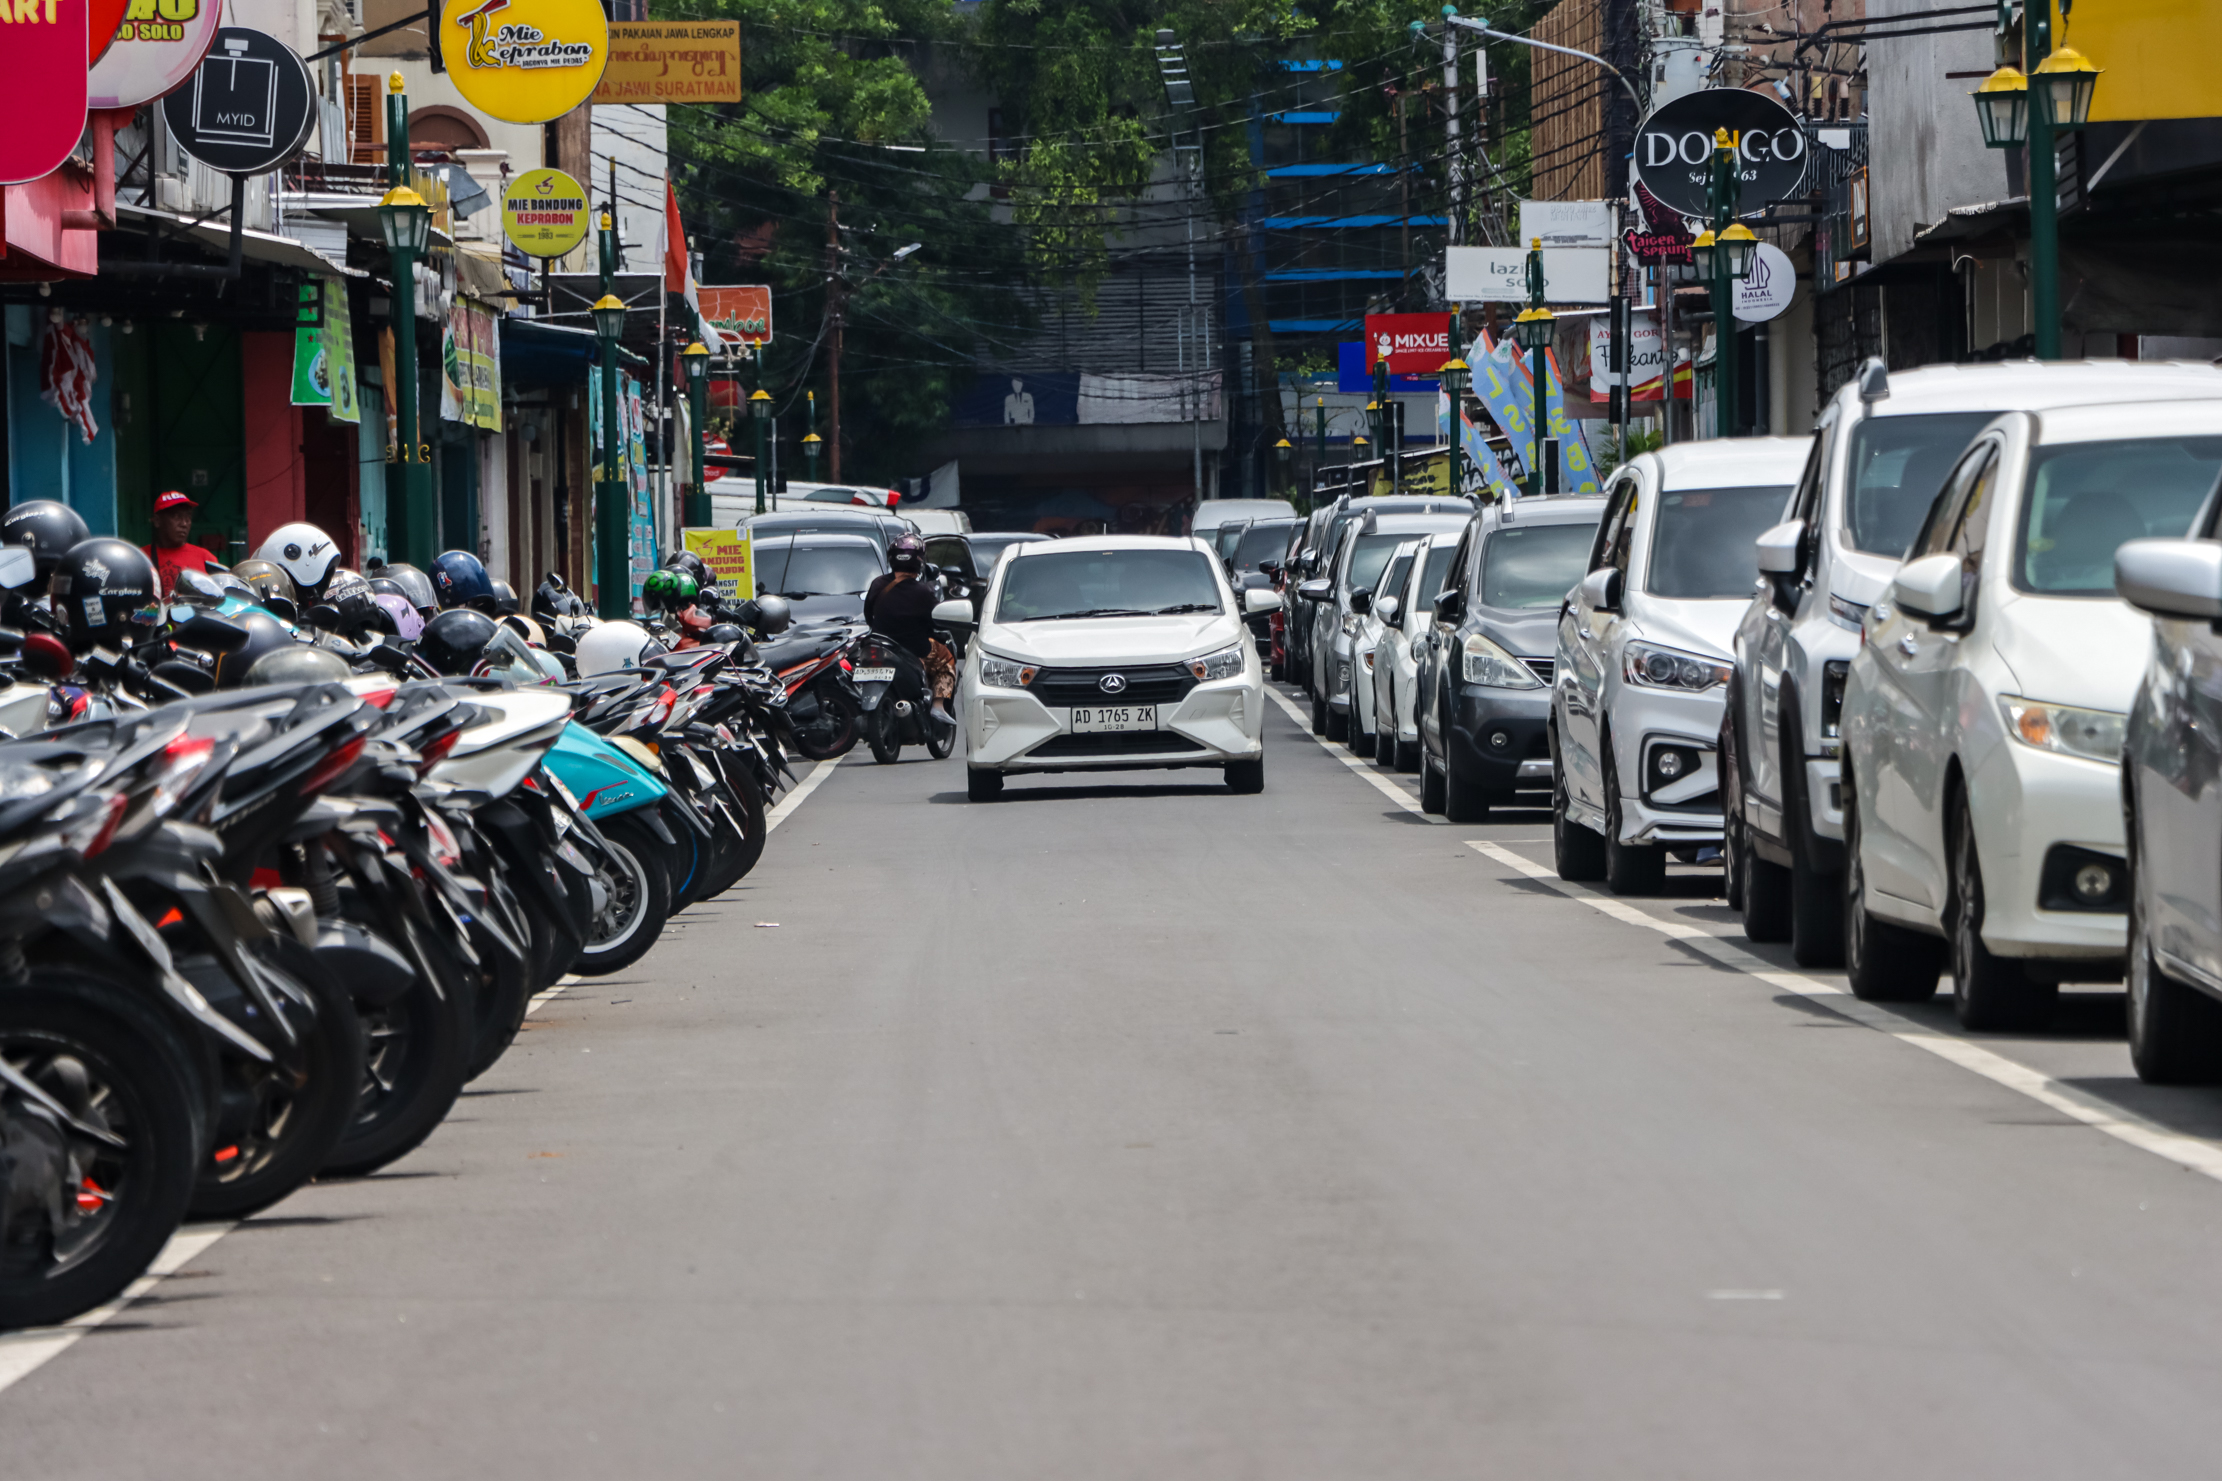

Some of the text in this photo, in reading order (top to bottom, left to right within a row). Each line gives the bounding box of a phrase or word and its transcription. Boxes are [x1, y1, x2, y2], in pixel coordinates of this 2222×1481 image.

[138, 23, 183, 40] SOLO
[500, 25, 542, 41] Mie
[622, 29, 662, 39] PAKAIAN
[664, 29, 689, 39] JAWA
[691, 27, 735, 39] LENGKAP
[615, 81, 651, 97] JAWI
[654, 80, 737, 97] SURATMAN
[216, 113, 256, 128] MYID
[507, 199, 583, 211] MIE BANDUNG
[516, 213, 574, 225] KEPRABON
[1741, 290, 1773, 299] HALAL
[1395, 333, 1449, 348] MIXUE
[716, 545, 742, 556] MIE
[1075, 707, 1153, 724] AD 1765 ZK
